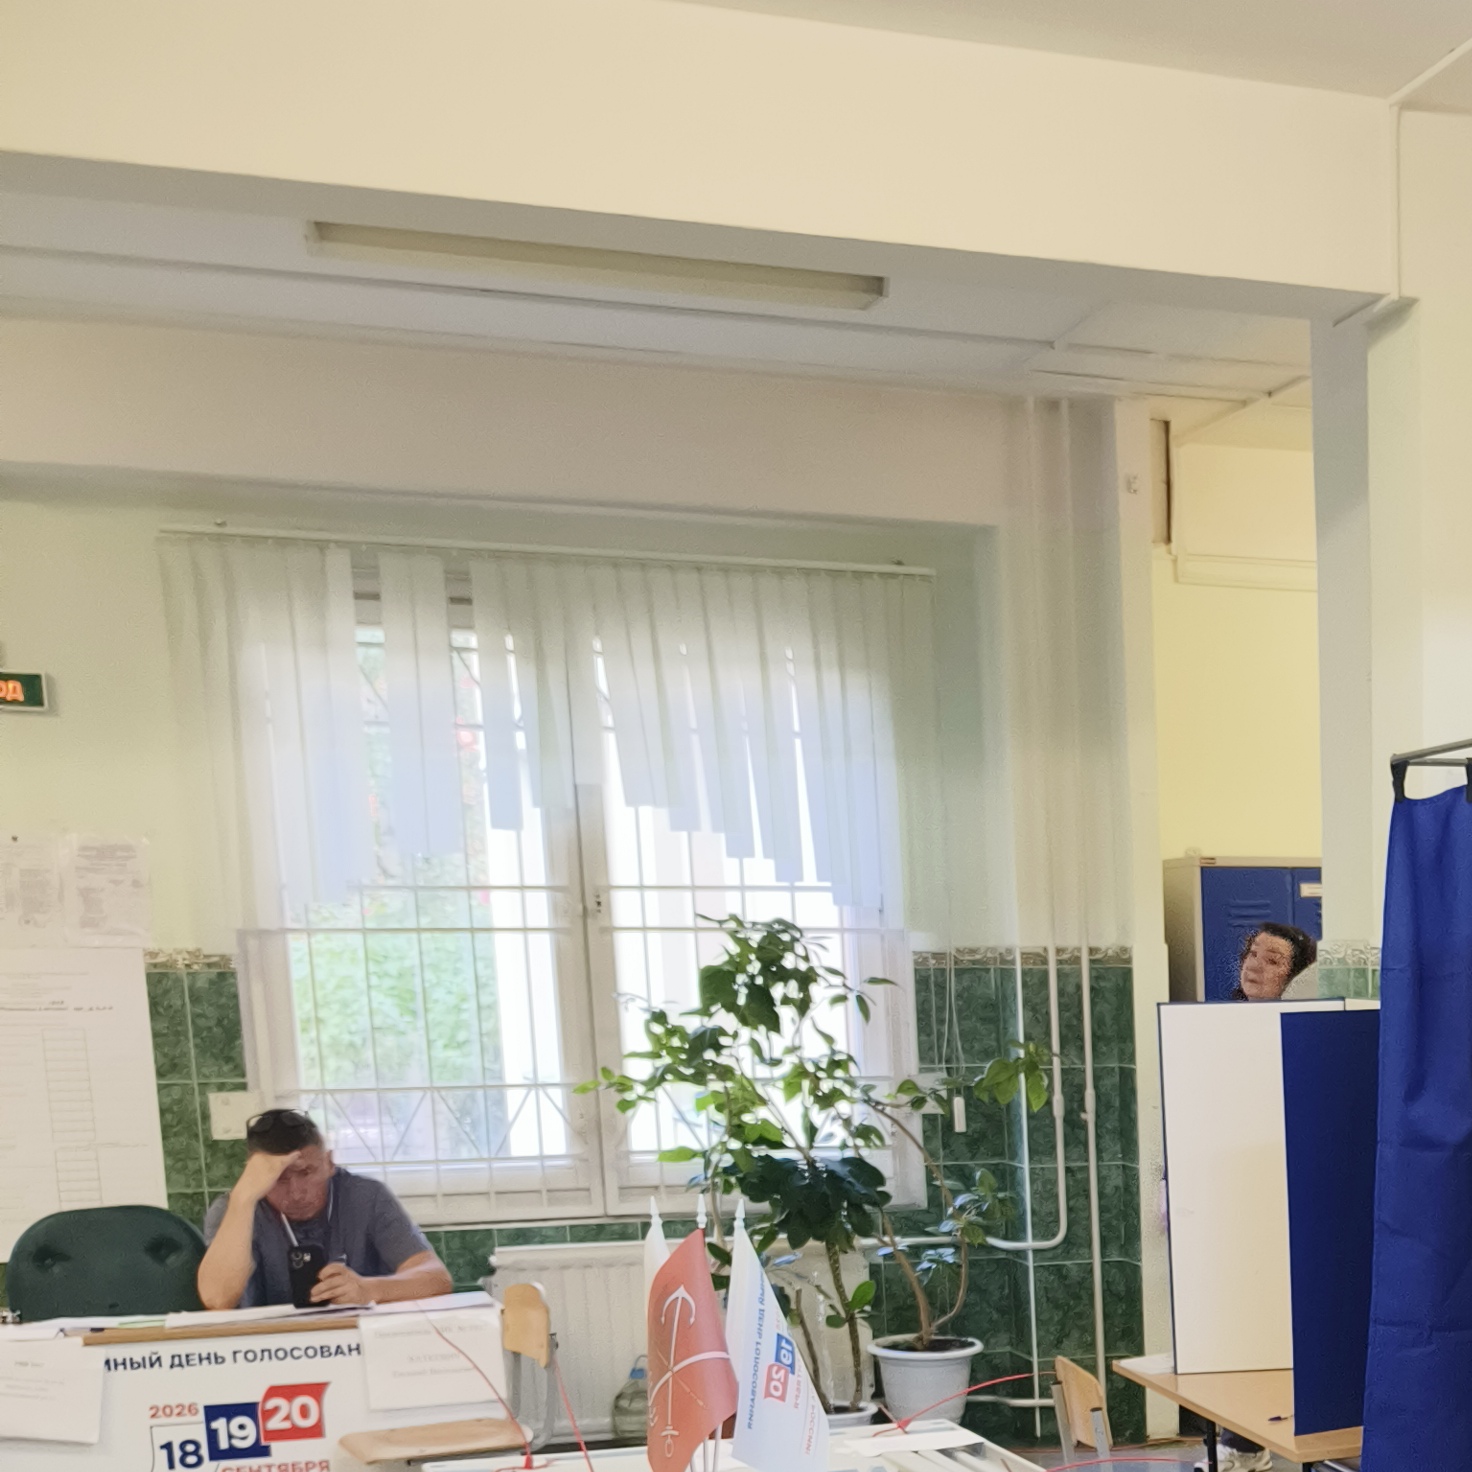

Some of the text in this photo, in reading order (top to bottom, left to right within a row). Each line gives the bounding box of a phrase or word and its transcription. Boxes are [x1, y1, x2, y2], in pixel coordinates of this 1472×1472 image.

[169, 1350, 226, 1371] ДЕНЬ
[232, 1342, 362, 1364] ГОЛОСОВАН
[149, 1403, 199, 1419] 2026
[159, 1394, 320, 1471] 18 19 20
